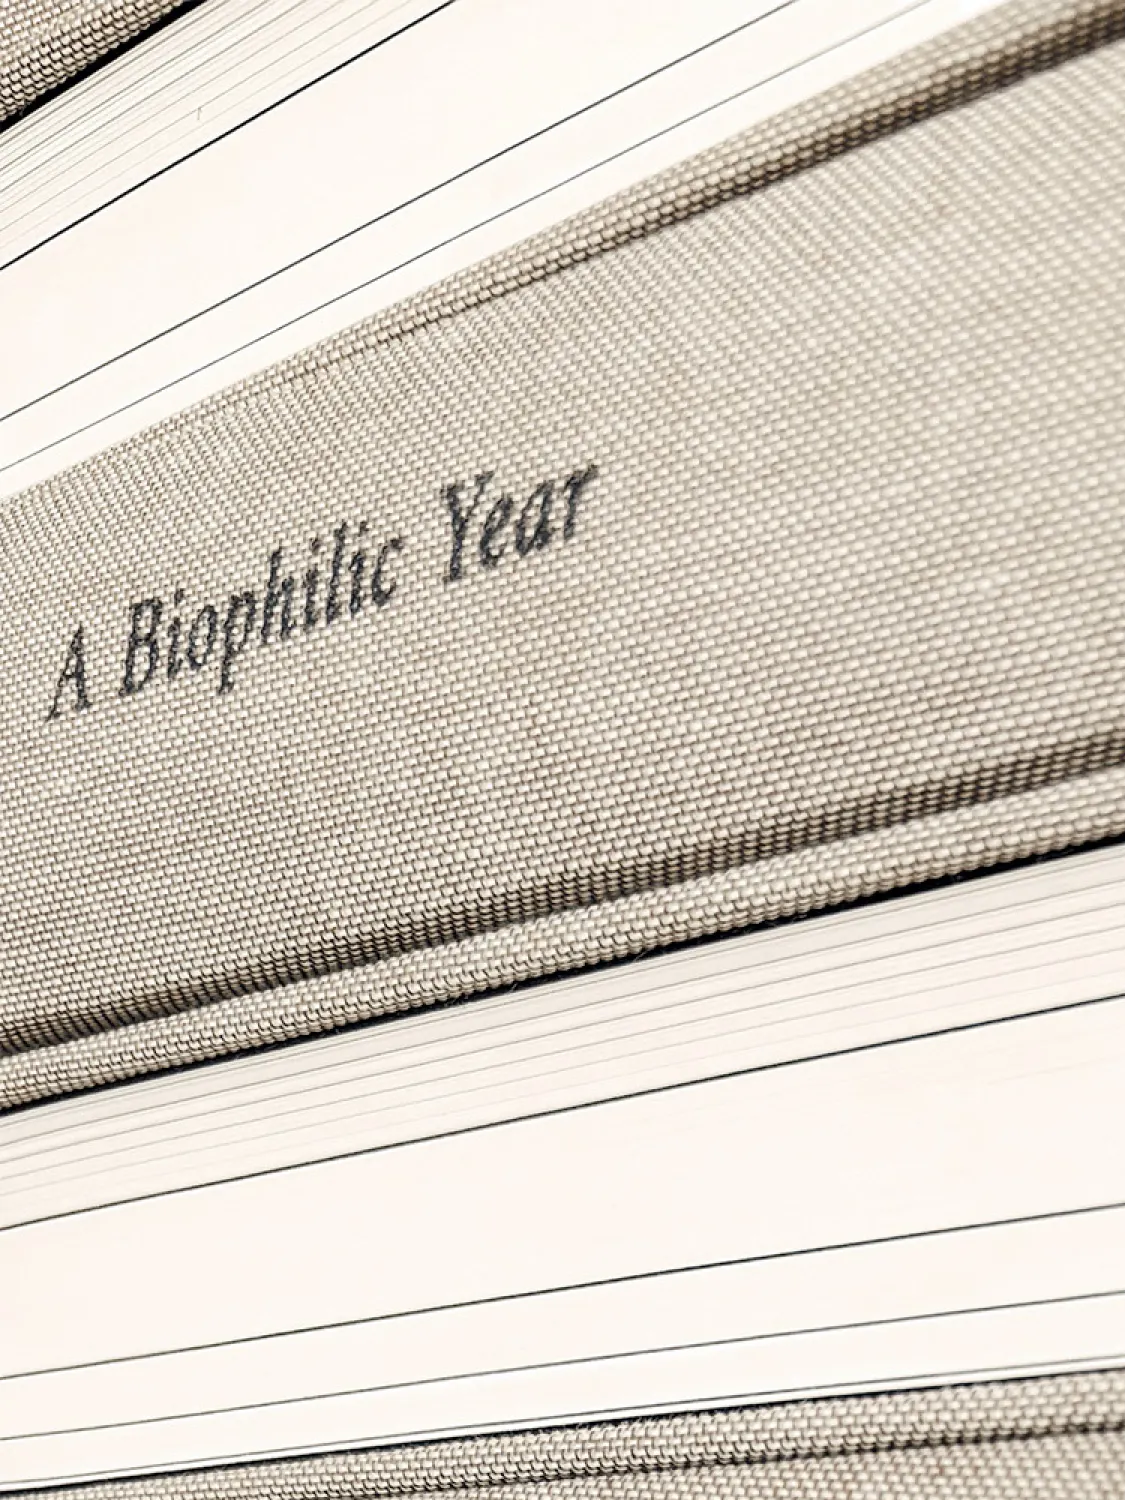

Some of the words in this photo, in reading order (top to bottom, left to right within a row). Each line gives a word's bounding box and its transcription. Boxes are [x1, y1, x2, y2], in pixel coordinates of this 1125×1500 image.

[45, 624, 94, 723] A
[116, 519, 406, 700] Biophilic
[438, 461, 601, 586] Year
